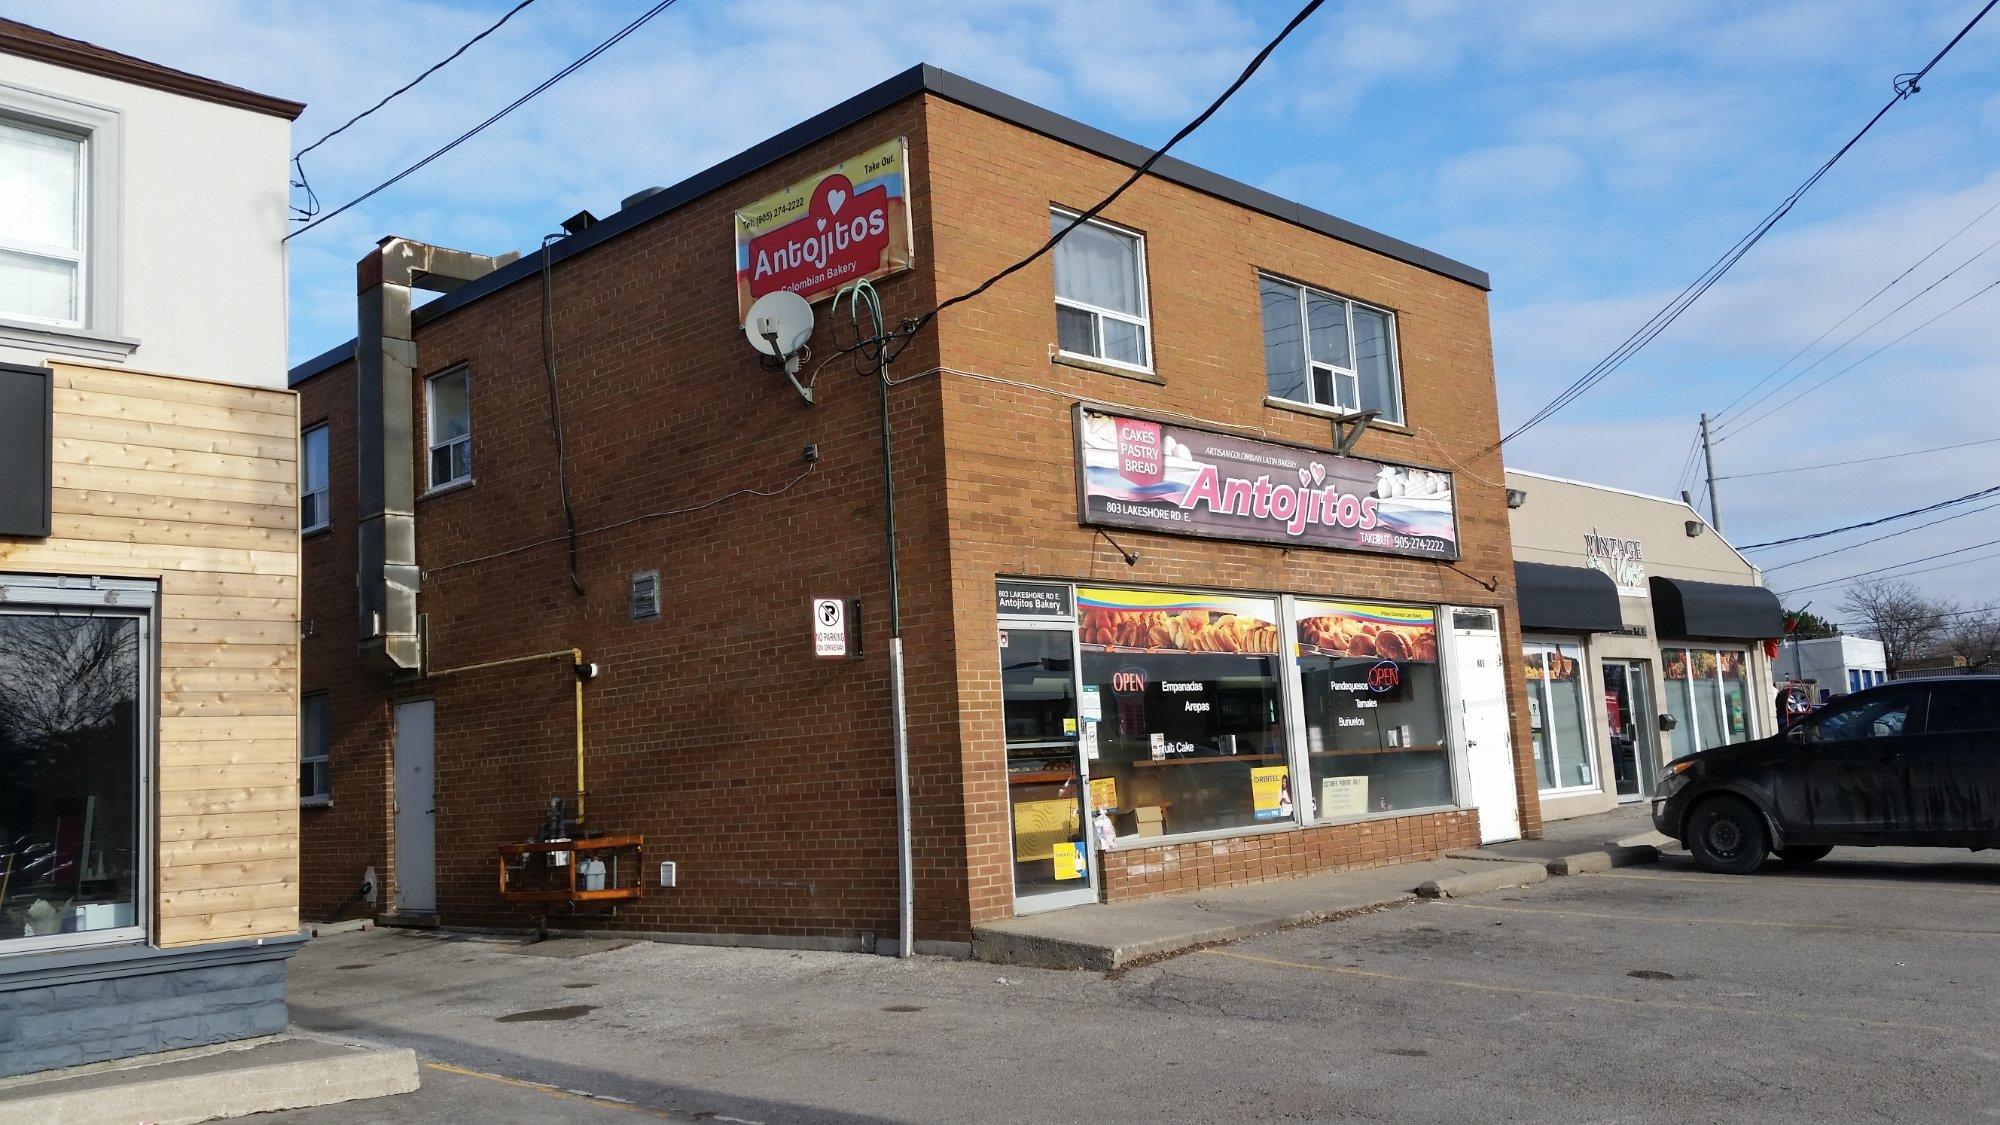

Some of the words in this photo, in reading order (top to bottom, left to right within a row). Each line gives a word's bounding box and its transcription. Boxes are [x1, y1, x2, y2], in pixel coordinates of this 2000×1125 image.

[864, 162, 880, 174] Take
[743, 221, 755, 231] Tel:
[756, 212, 773, 227] (905)
[773, 197, 805, 218] 274-2222
[754, 208, 886, 281] Antojitos
[827, 261, 857, 279] Bakery
[1123, 427, 1155, 444] CAKES
[1121, 443, 1159, 460] PASTRY
[1205, 446, 1230, 457] ARTISAN
[1230, 451, 1262, 462] COLOMBIAN
[1262, 456, 1278, 465] LATIN
[1278, 459, 1297, 468] BAKERY
[1125, 460, 1158, 475] BREAD
[1179, 464, 1378, 536] Antojitos
[1106, 502, 1122, 514] 803
[1123, 503, 1170, 520] LAKESHORE
[1170, 510, 1184, 522] RD.
[1184, 512, 1192, 522] E.
[1394, 536, 1445, 552] 905-274-2222
[1584, 532, 1643, 561] VINTAGE
[1010, 590, 1045, 600] LAKESHORE
[1045, 592, 1055, 600] RD
[1000, 597, 1034, 610] Antojitos
[1035, 599, 1061, 611] Bakery
[815, 632, 823, 642] NO
[823, 632, 845, 642] PARKING
[1113, 672, 1145, 692] OPEN
[1369, 668, 1399, 685] OPEN
[1162, 681, 1203, 694] Empanadas
[1184, 701, 1210, 713] Arepas
[1355, 698, 1378, 708] Tamales
[1338, 716, 1365, 727] Buñuelos
[1161, 742, 1175, 753] ruit
[1175, 741, 1194, 753] Cake
[1253, 774, 1279, 783] ORBITEL
